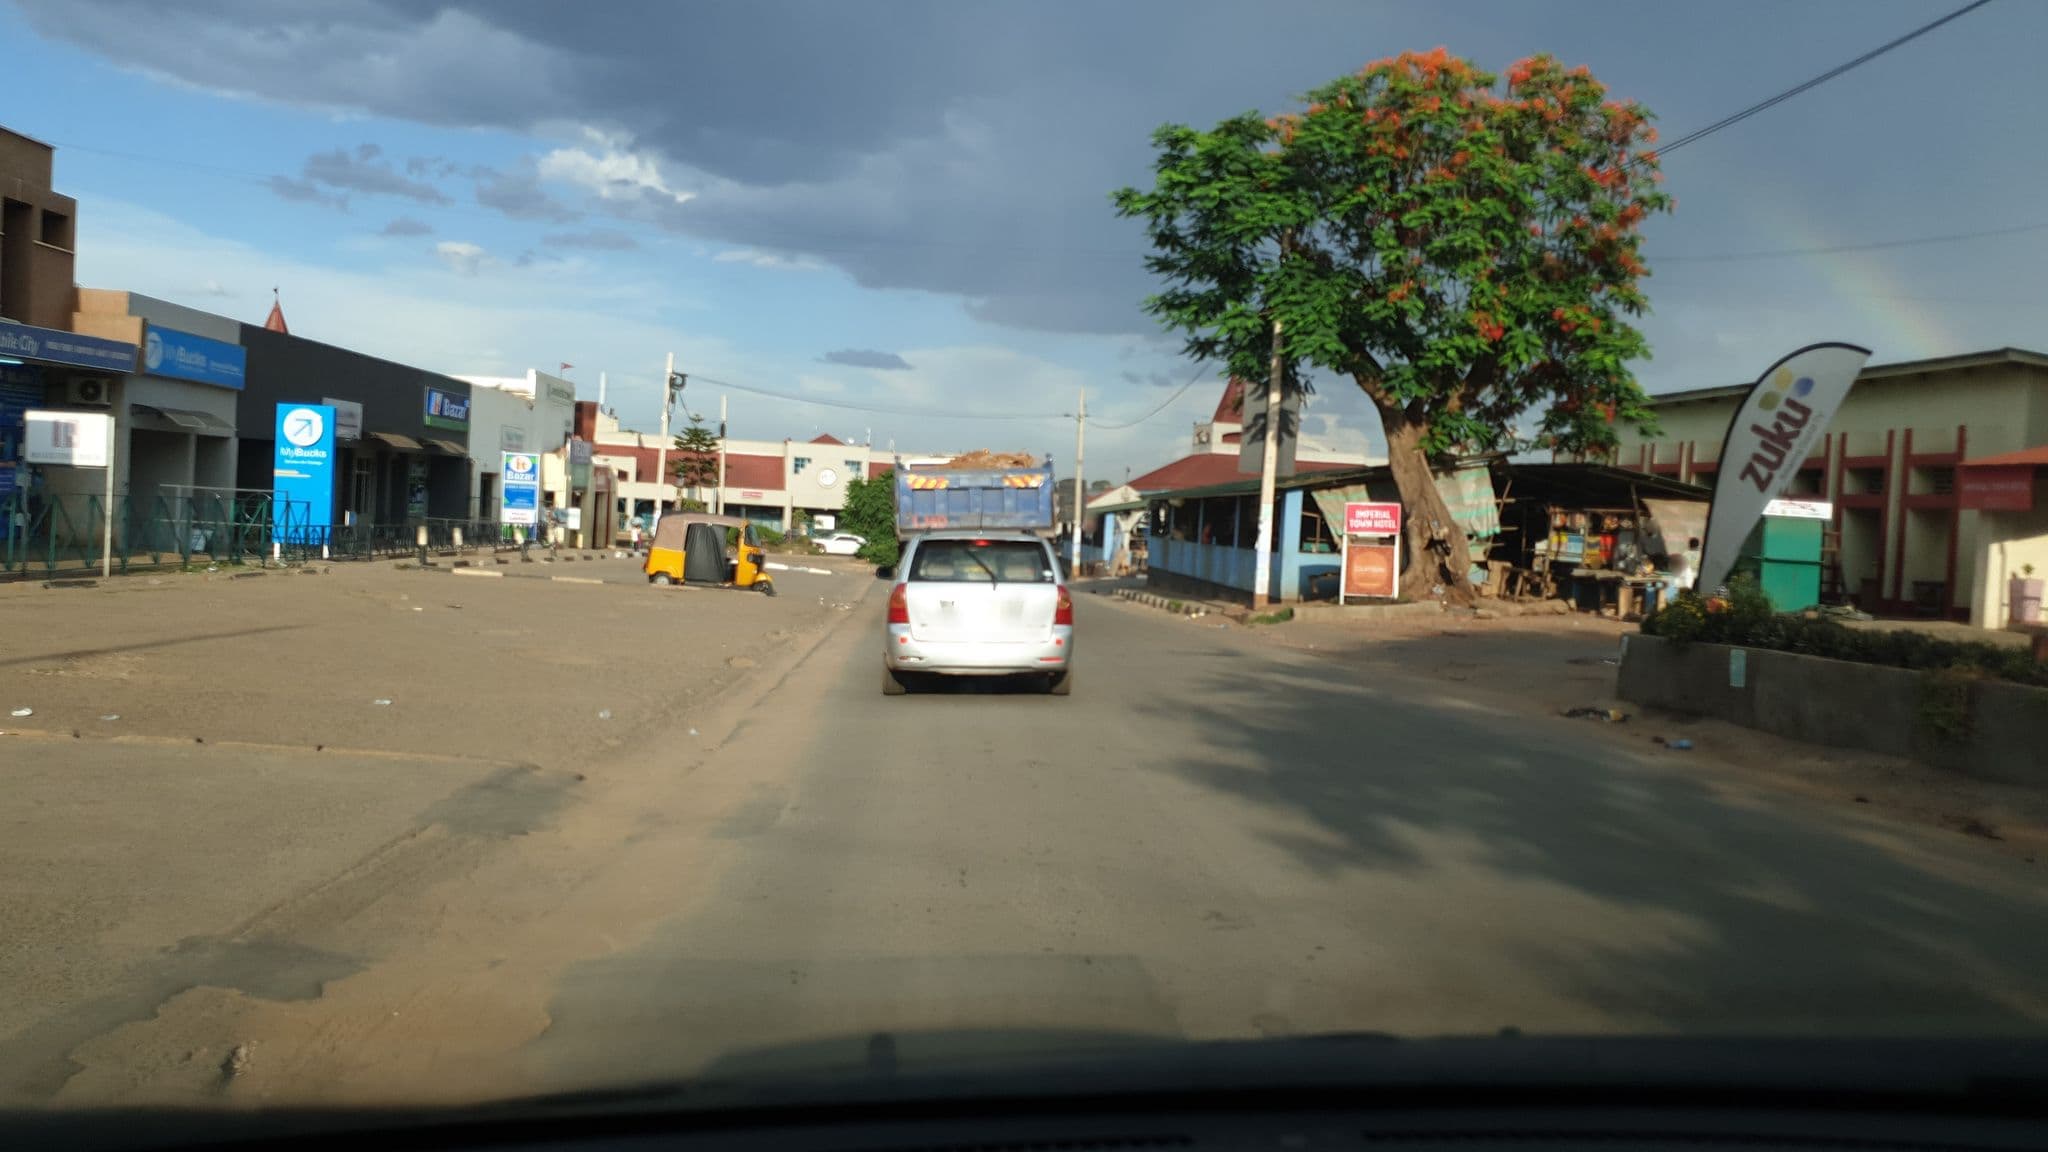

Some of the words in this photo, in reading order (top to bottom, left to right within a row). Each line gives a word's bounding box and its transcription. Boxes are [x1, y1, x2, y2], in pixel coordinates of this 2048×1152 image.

[1739, 397, 1812, 493] zuku
[279, 447, 327, 461] MyBucks
[506, 471, 535, 482] Bazar
[1355, 509, 1391, 520] IMPERIAL
[1349, 519, 1373, 529] TOWN
[1374, 519, 1397, 530] HOTEL
